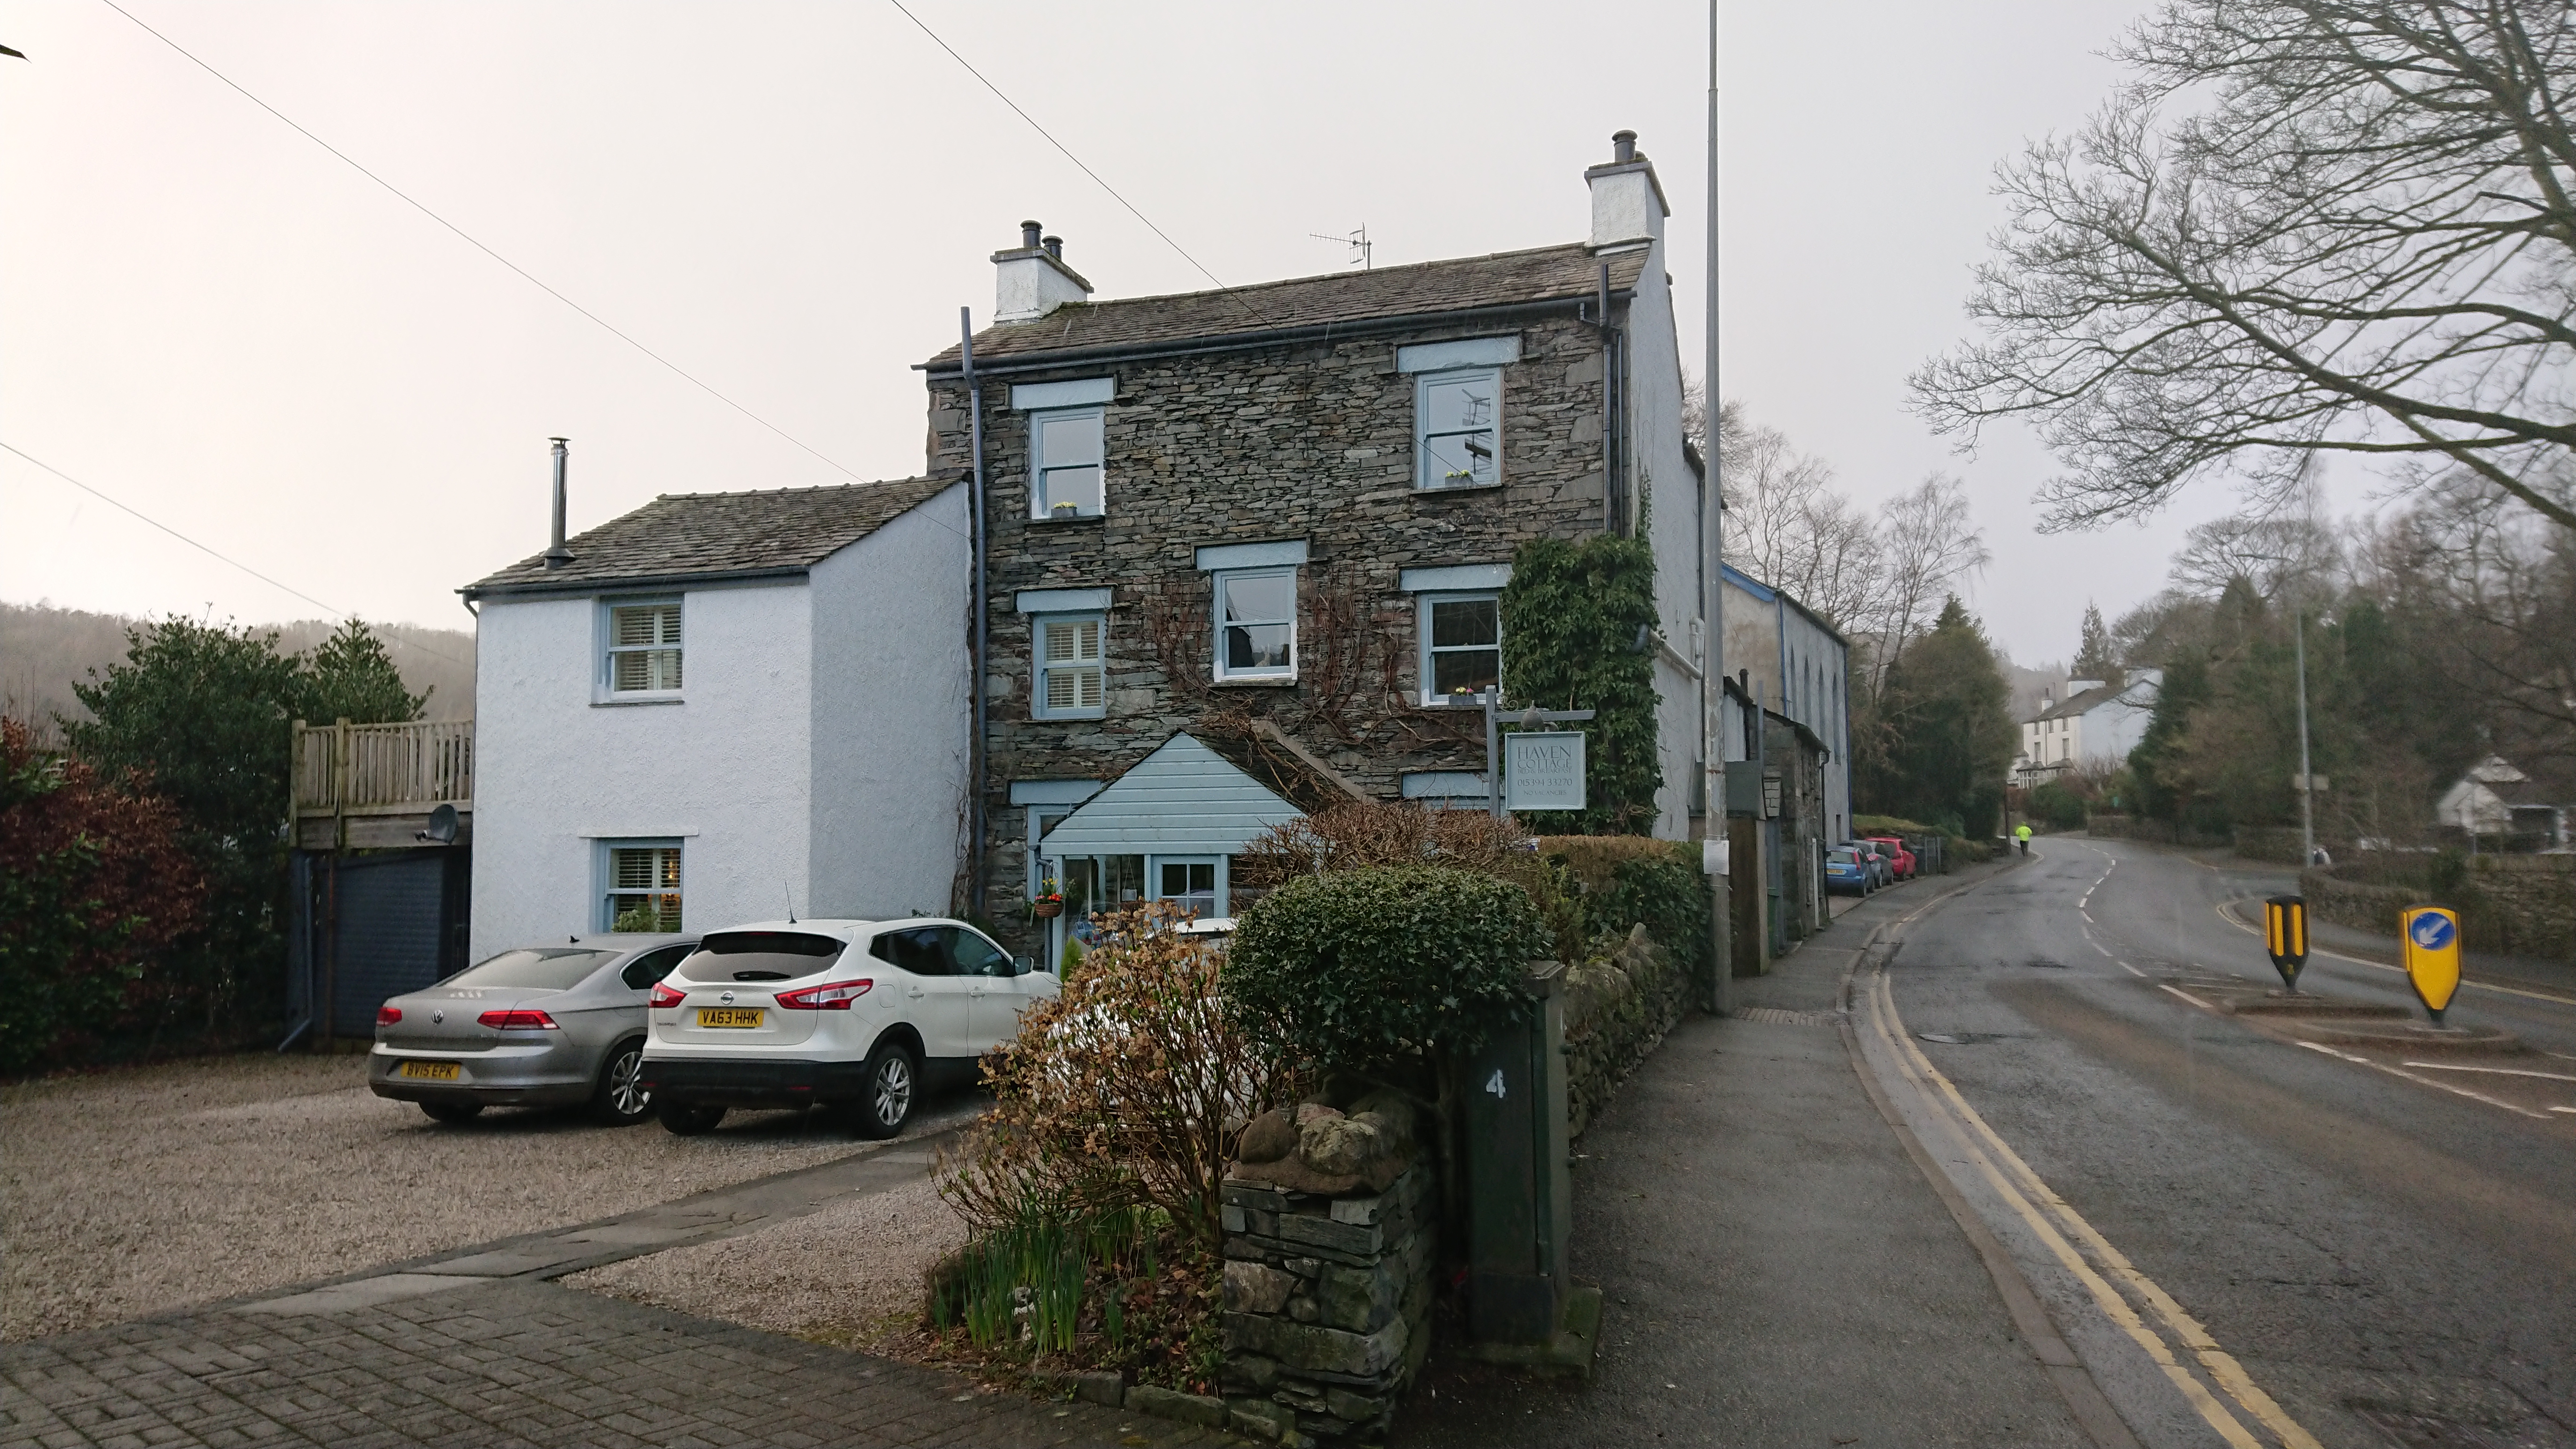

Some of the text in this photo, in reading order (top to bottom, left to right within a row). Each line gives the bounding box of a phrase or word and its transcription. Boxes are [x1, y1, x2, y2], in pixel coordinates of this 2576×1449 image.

[1518, 746, 1571, 759] HAVEN
[1517, 759, 1572, 768] COTTAGE
[703, 1011, 759, 1024] VA63 HHK
[407, 1063, 454, 1077] BV15 EPK
[1486, 1069, 1506, 1098] 4
